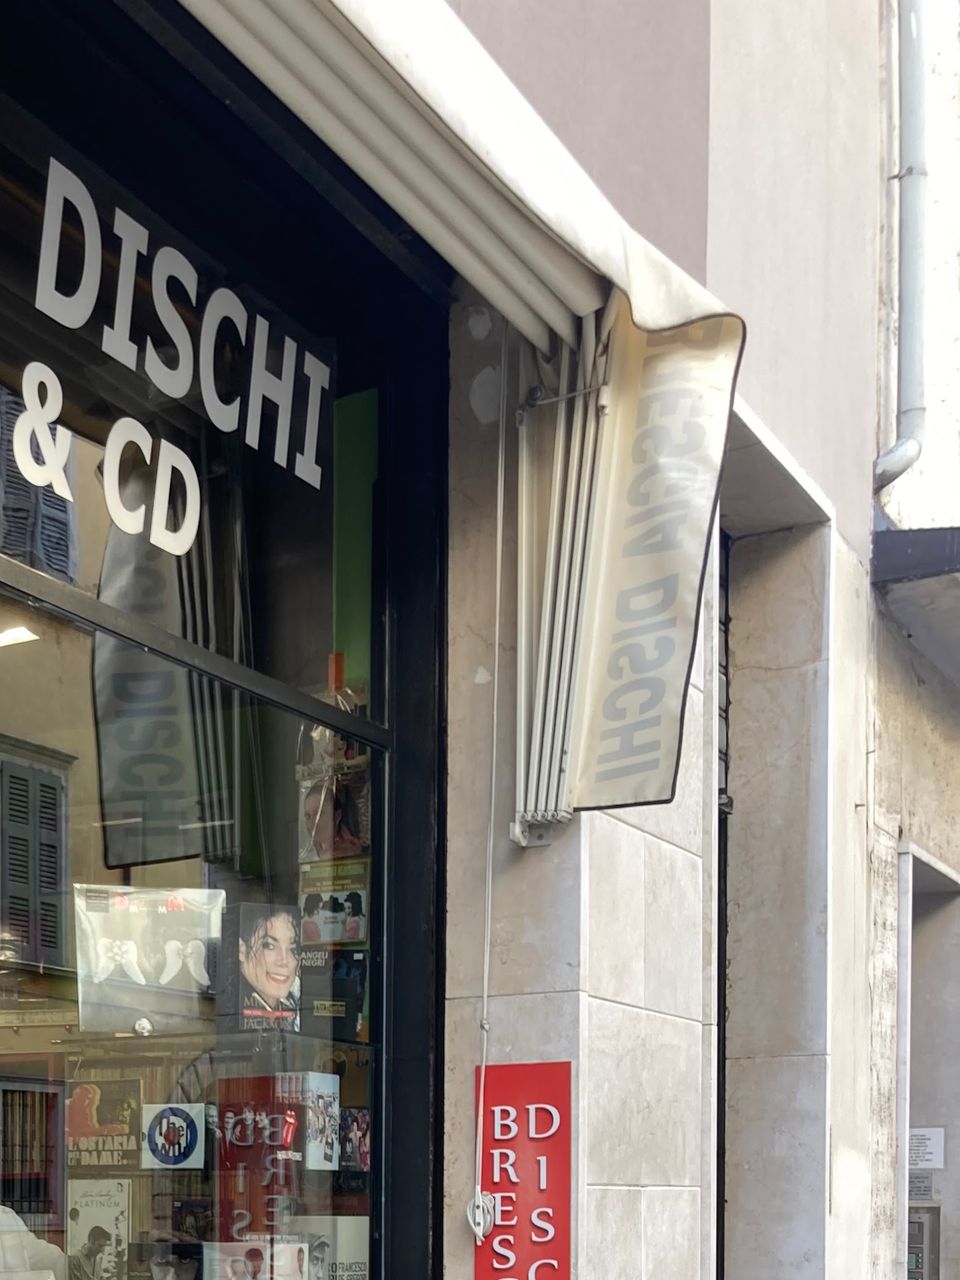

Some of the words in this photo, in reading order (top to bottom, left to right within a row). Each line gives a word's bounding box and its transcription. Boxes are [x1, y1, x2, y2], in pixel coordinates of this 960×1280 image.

[34, 157, 335, 491] DISCHI
[12, 360, 76, 503] &
[103, 415, 201, 556] CD
